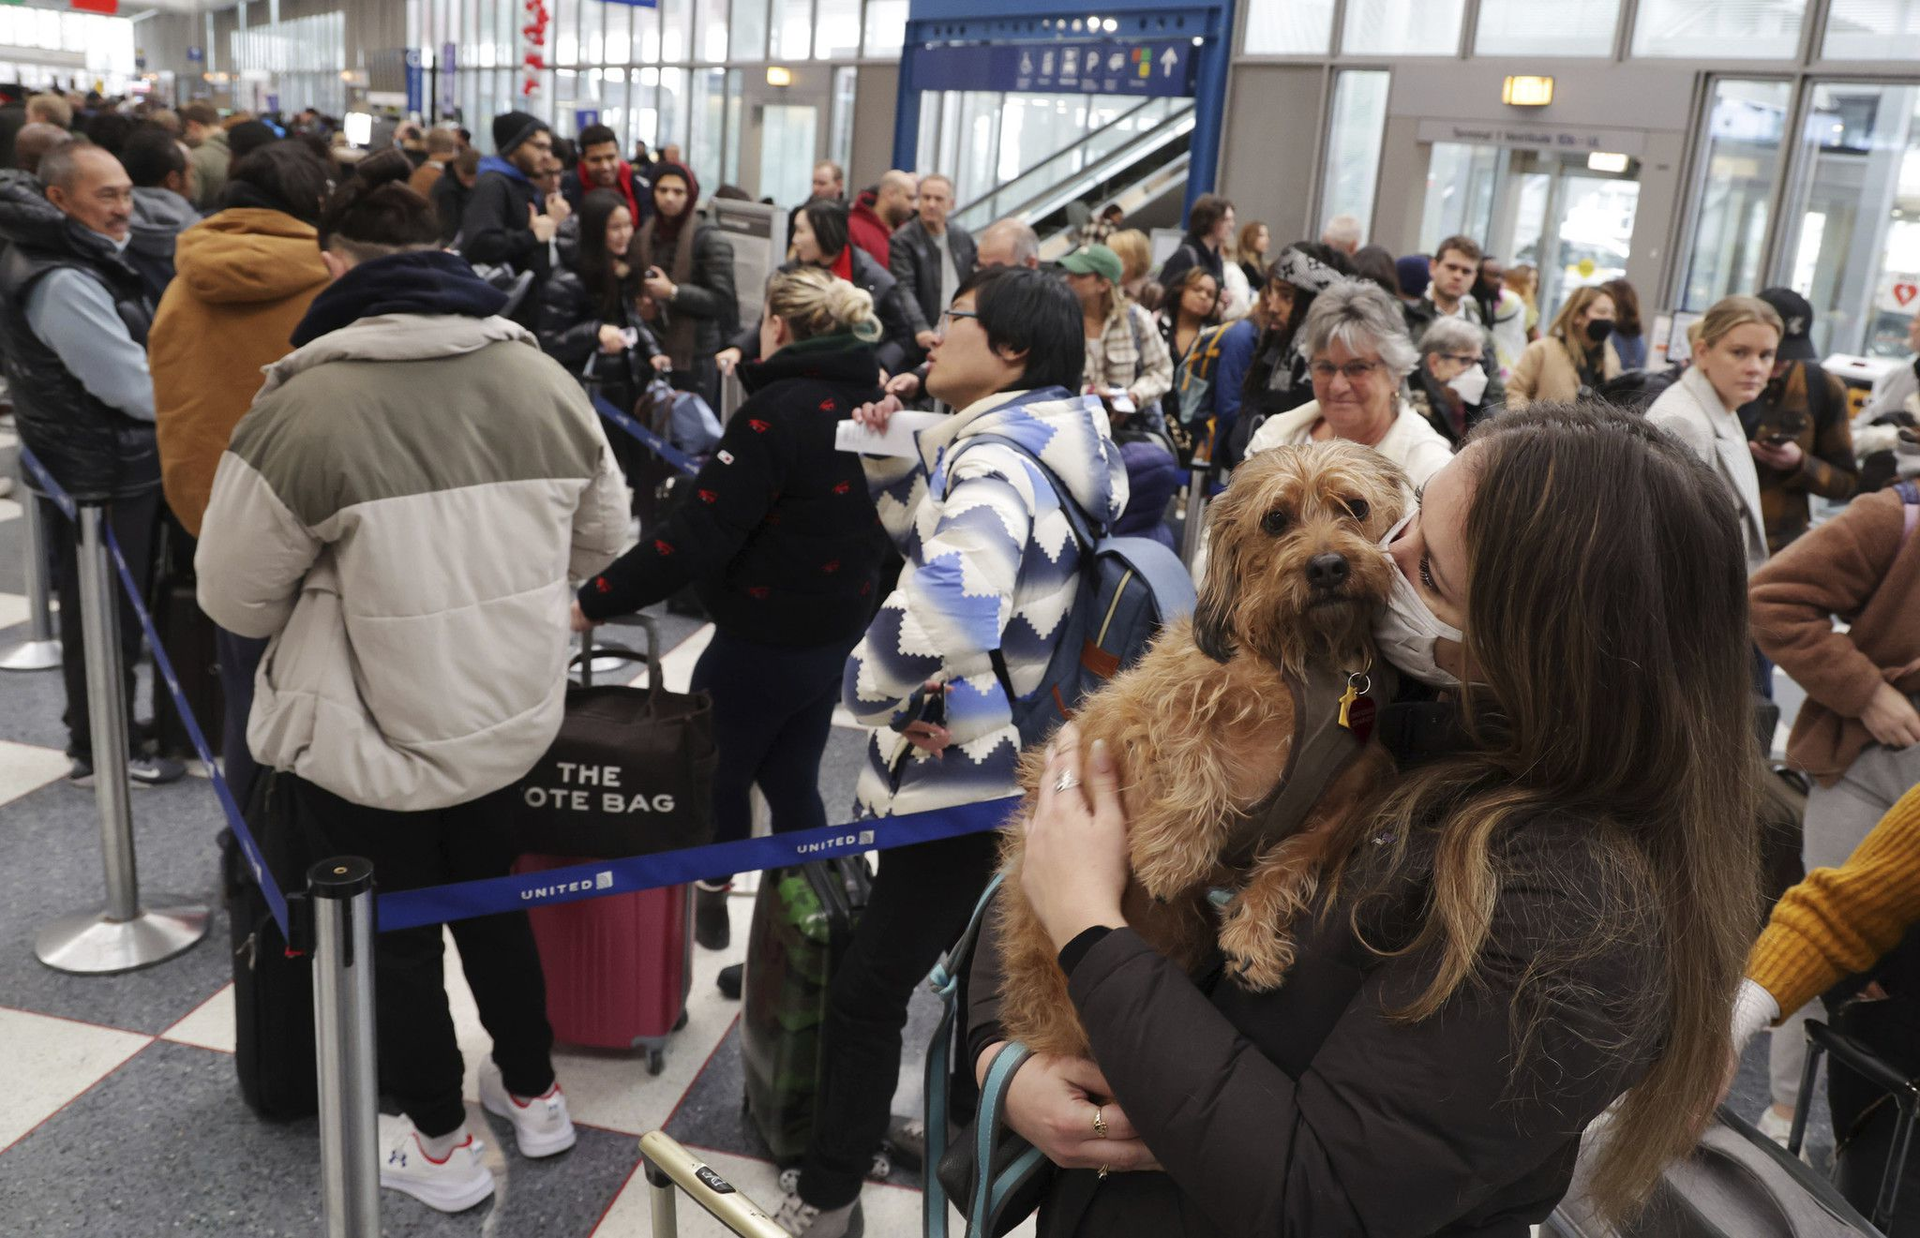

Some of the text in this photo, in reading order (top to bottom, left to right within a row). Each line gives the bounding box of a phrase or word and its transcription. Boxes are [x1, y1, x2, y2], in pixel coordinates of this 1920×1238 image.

[556, 762, 621, 788] THE
[524, 787, 675, 813] OTE BAG
[797, 835, 856, 854] UNITED
[520, 879, 593, 900] UNITED
